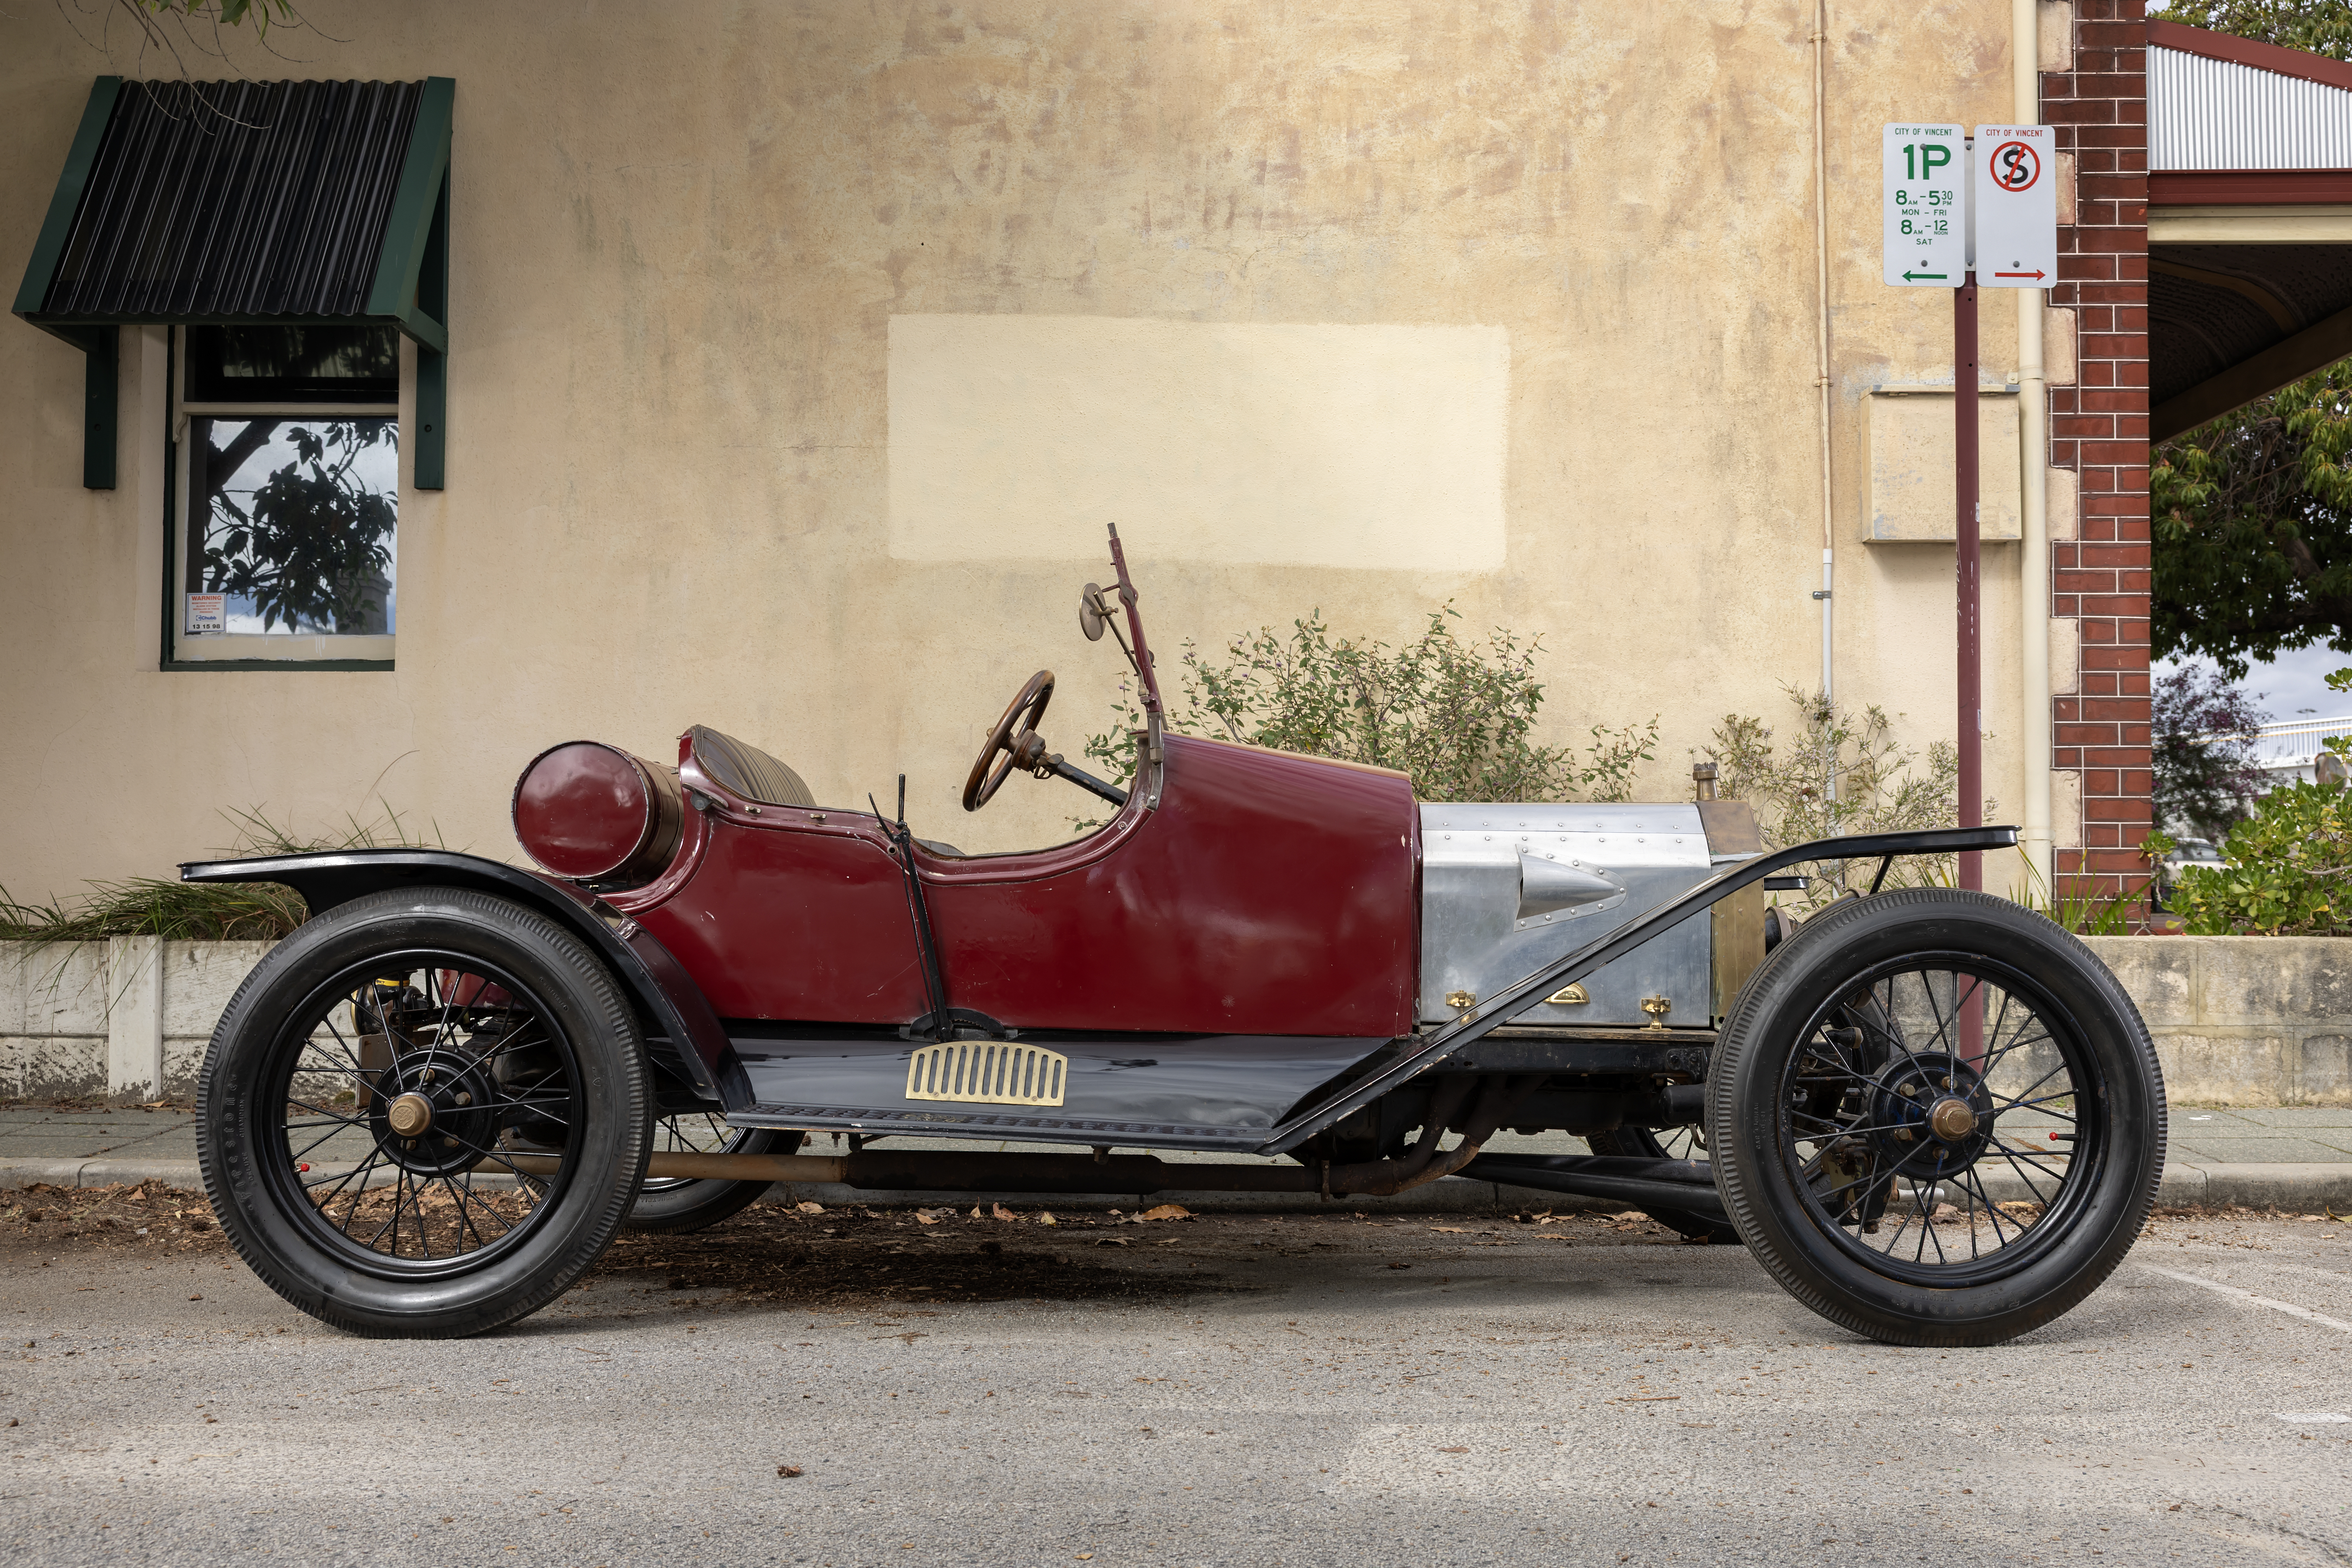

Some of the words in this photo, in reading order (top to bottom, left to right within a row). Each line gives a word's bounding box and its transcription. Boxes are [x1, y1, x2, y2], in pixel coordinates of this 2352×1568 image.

[1903, 144, 1951, 180] 1P
[224, 1083, 253, 1203] Firestone
[1771, 1132, 1786, 1183] INDUSTRIA
[242, 1151, 255, 1181] DELUXE
[1900, 1291, 2020, 1316] Firestone
